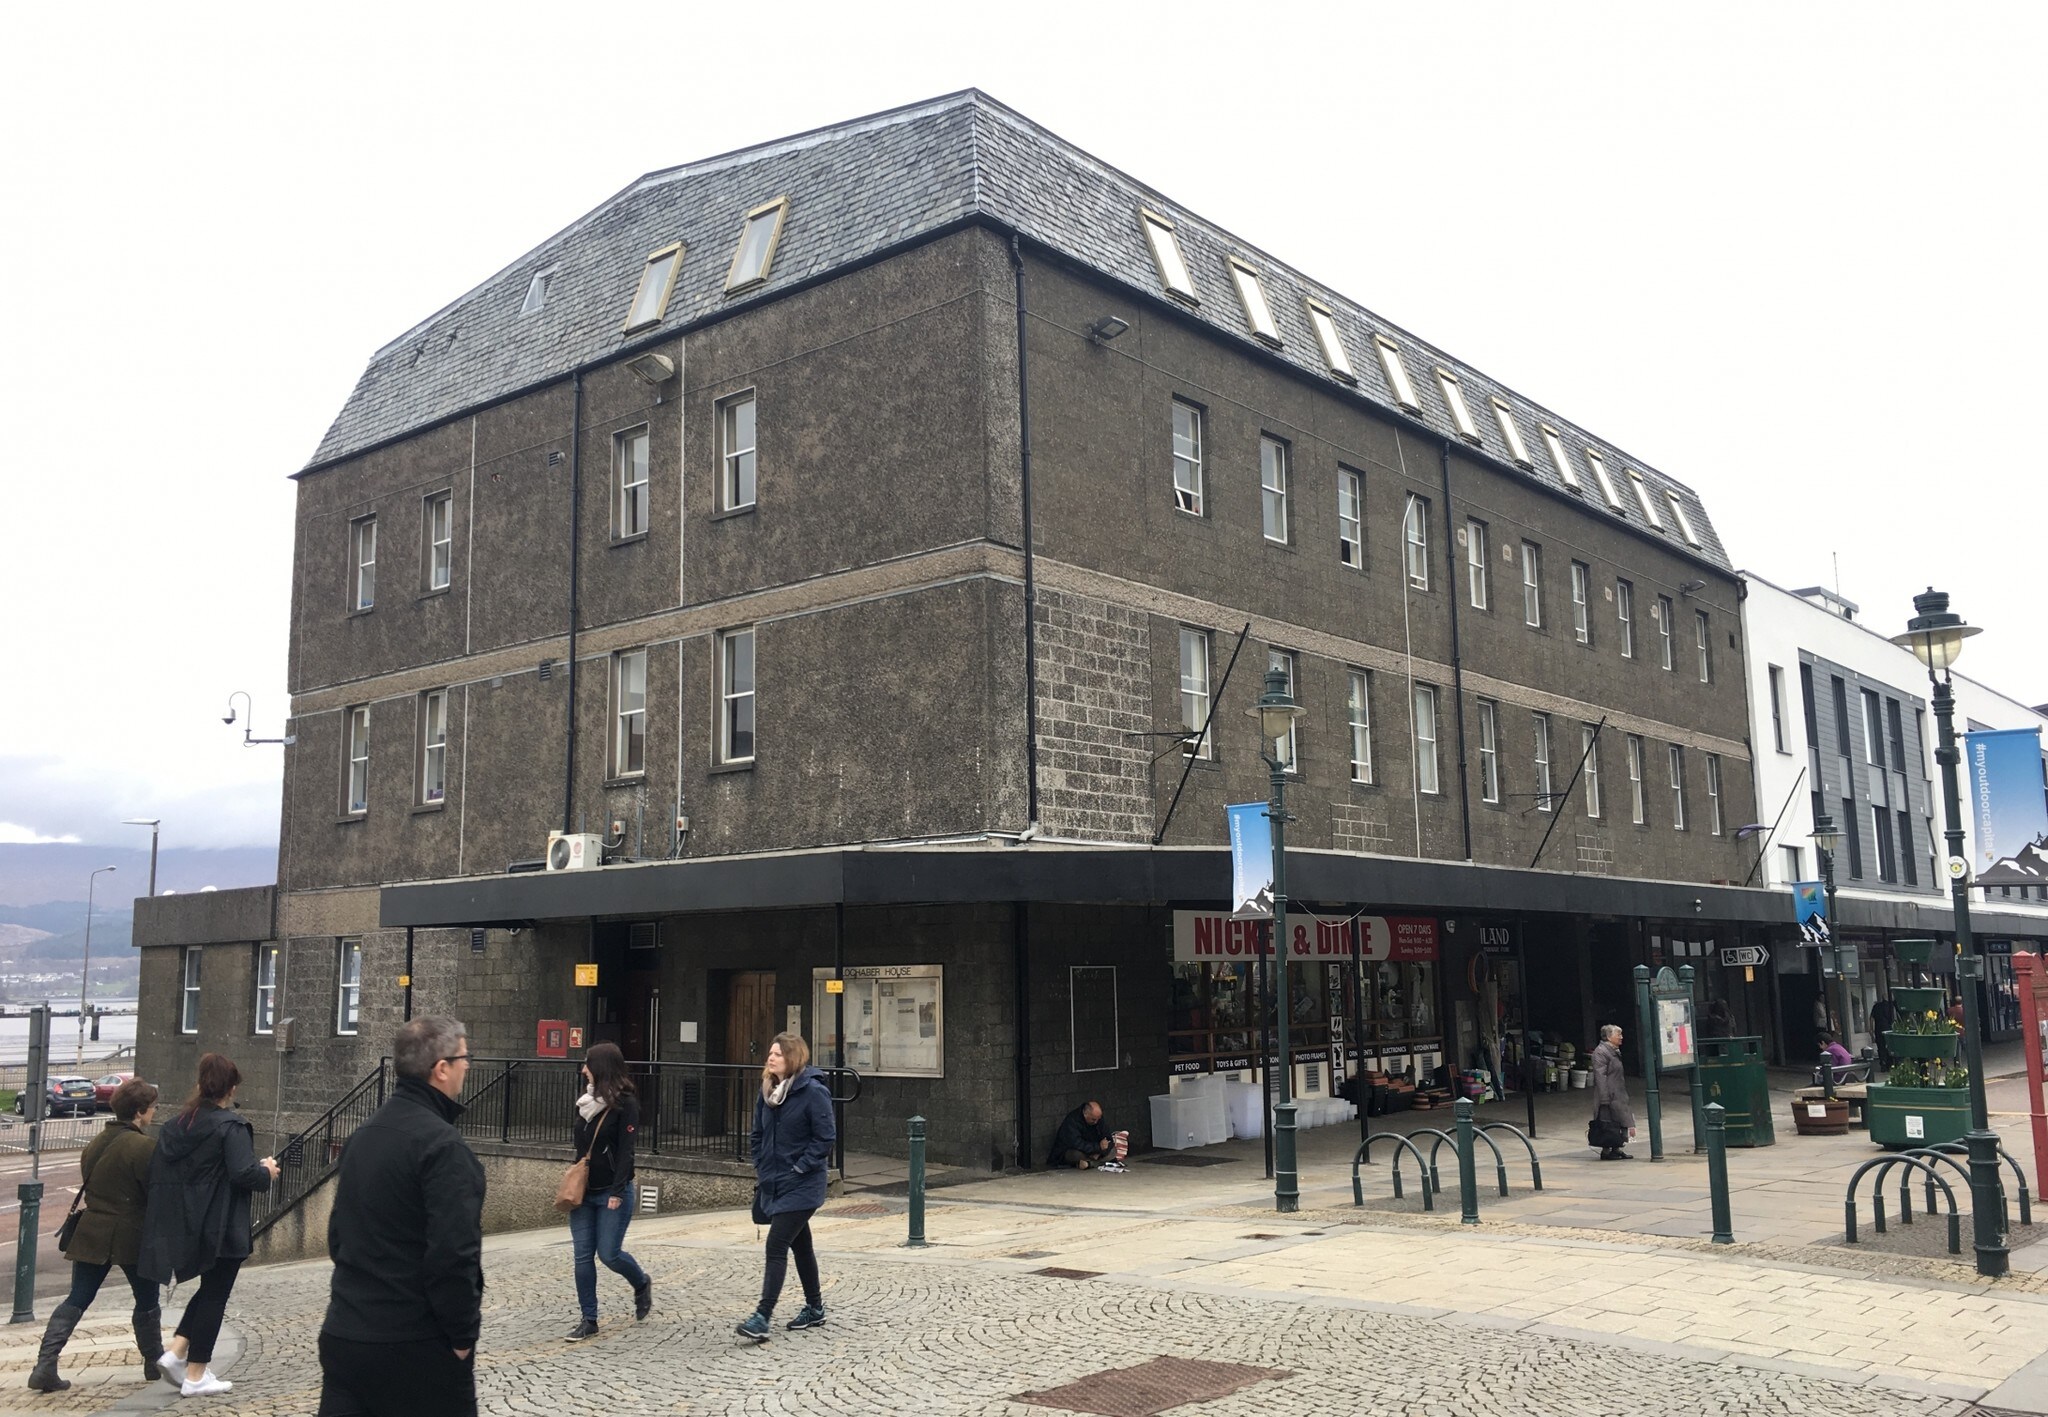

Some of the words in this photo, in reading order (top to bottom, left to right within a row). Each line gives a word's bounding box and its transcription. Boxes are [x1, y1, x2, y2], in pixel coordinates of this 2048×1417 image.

[1974, 743, 1996, 852] #myoutdoorcapital
[1397, 923, 1413, 934] OPEN
[1413, 924, 1418, 934] 7
[1418, 924, 1432, 935] DAYS
[1194, 917, 1288, 955] NICKE
[1293, 924, 1311, 956] &
[1741, 951, 1752, 960] WC
[884, 966, 912, 976] HOUSE
[1382, 1045, 1407, 1054] ELECTRONICS
[1310, 1051, 1327, 1059] FRAMES
[1174, 1063, 1185, 1072] PET
[1185, 1062, 1200, 1071] FOOD
[1216, 1060, 1229, 1068] TOYS
[1234, 1059, 1248, 1067] GIFTS
